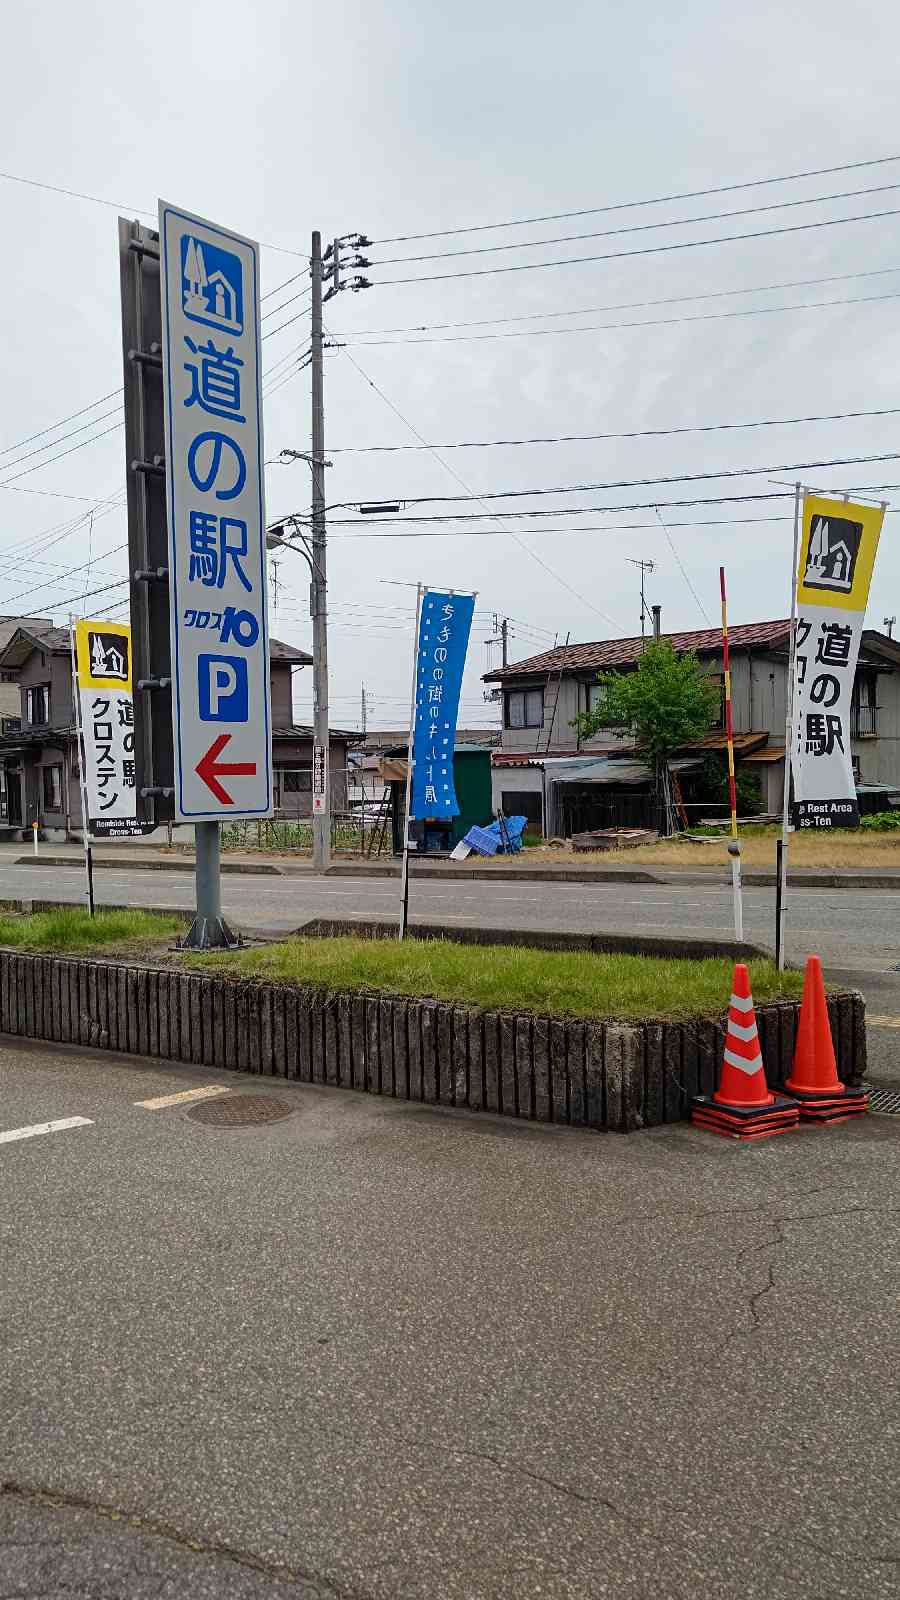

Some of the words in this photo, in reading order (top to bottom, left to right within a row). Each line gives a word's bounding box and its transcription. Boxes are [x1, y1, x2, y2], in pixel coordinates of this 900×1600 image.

[184, 336, 252, 592] 道の駅
[184, 606, 259, 647] クロス10
[208, 661, 237, 715] P
[805, 622, 852, 756] 道の駅
[92, 698, 119, 811] クロステン
[800, 816, 832, 826] ss-Ten
[807, 803, 828, 813] Rest
[830, 803, 852, 813] Area
